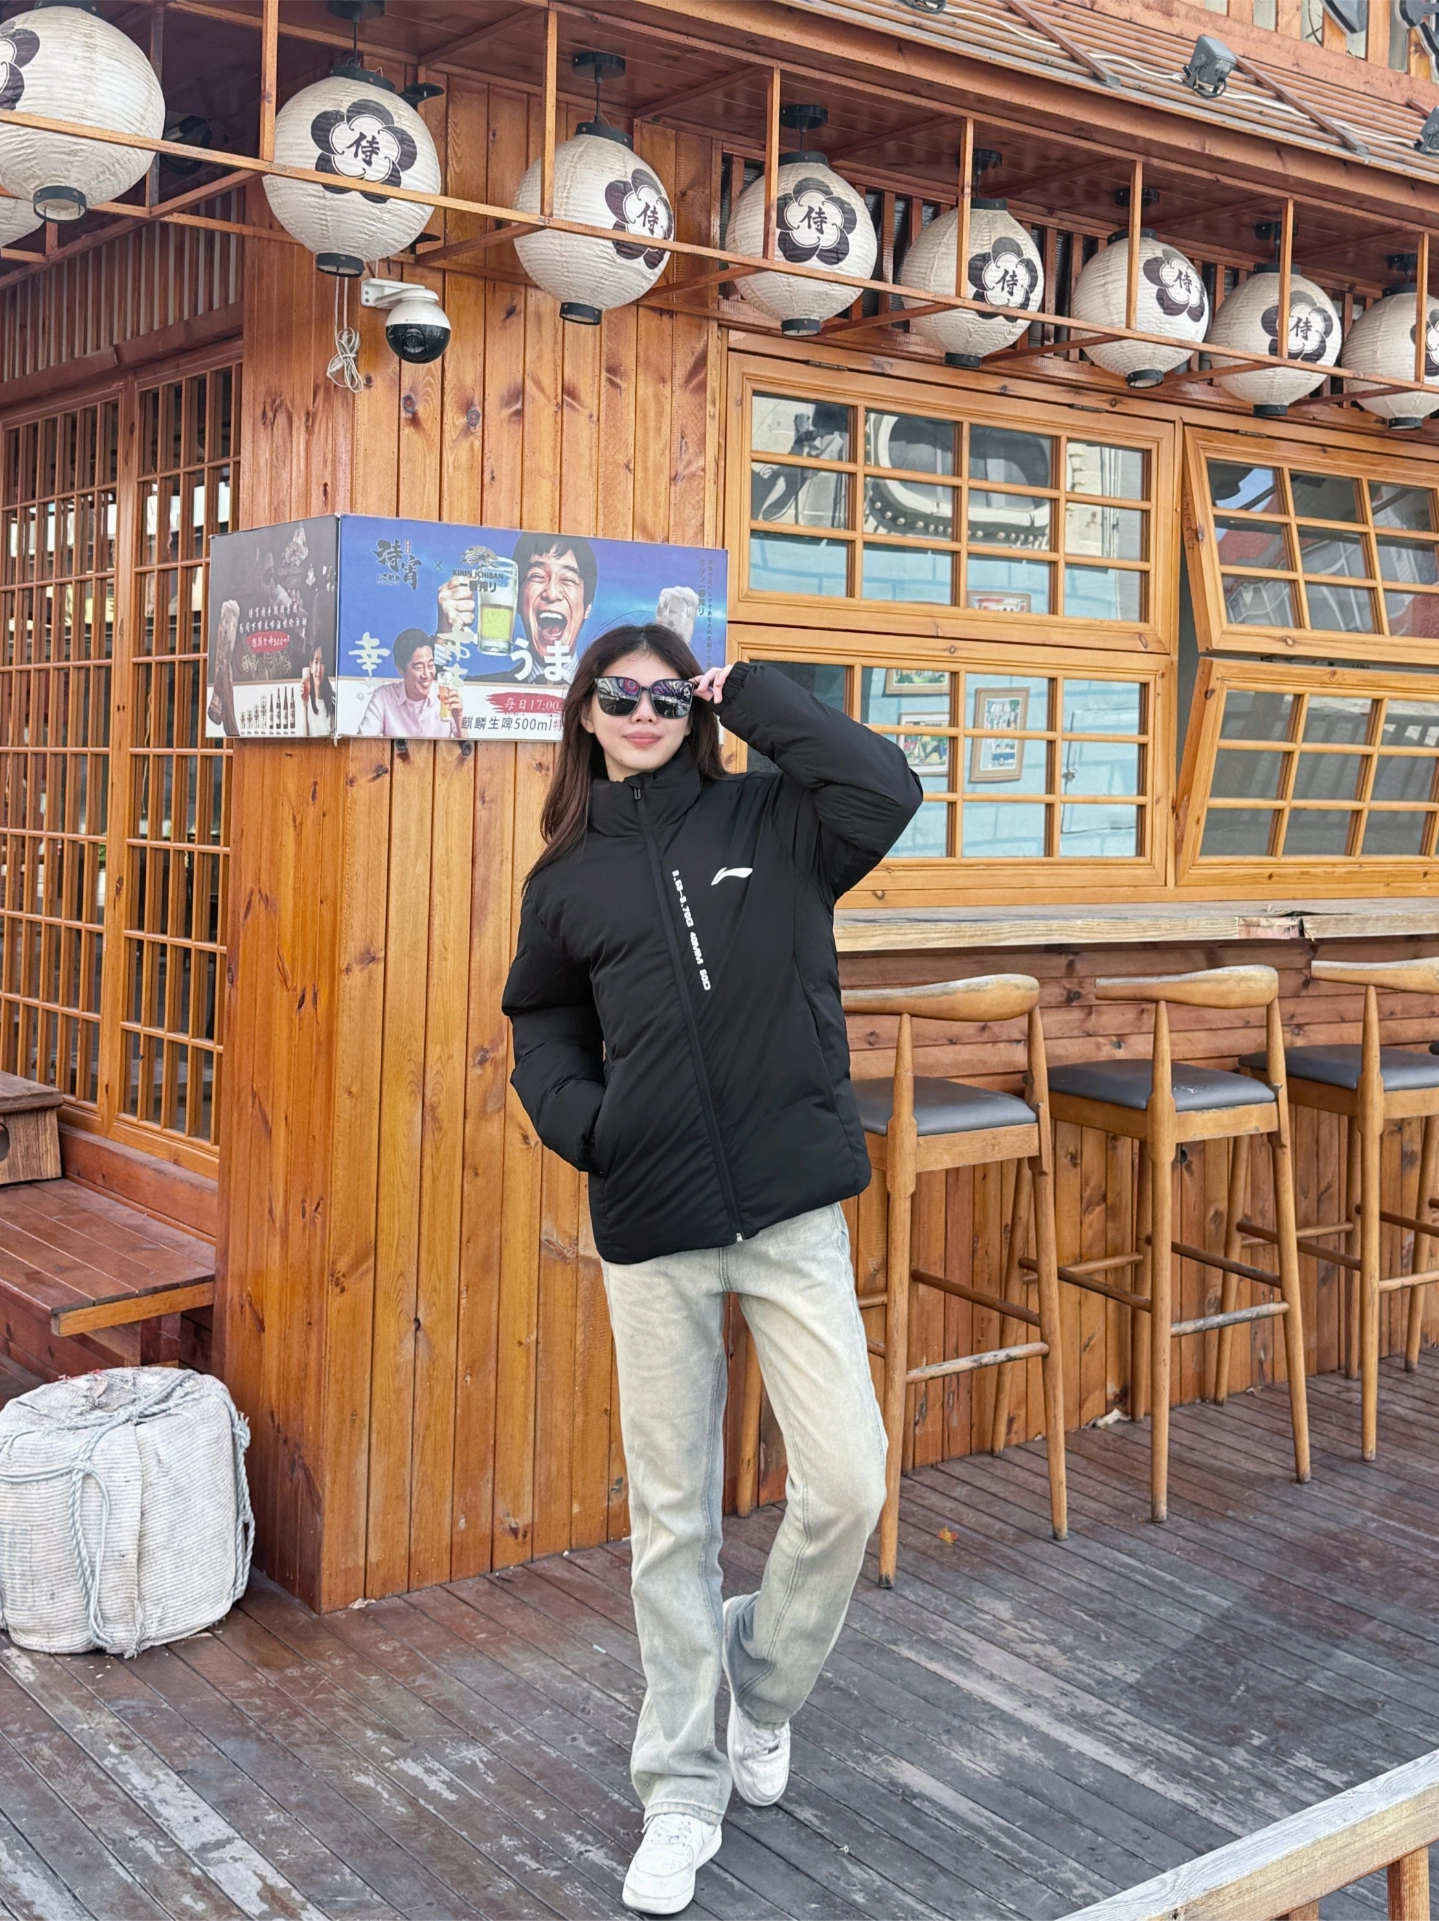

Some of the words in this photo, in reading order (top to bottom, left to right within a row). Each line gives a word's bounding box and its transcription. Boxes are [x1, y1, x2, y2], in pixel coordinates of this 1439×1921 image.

[346, 131, 380, 167] 侍
[637, 202, 659, 236] 侍
[800, 205, 828, 235] 侍
[995, 268, 1019, 297] 侍
[1173, 269, 1193, 294] 侍
[1289, 316, 1313, 341] 侍
[453, 570, 473, 578] KIRIN
[476, 571, 503, 580] ICHIBAN
[690, 931, 704, 965] 40MM
